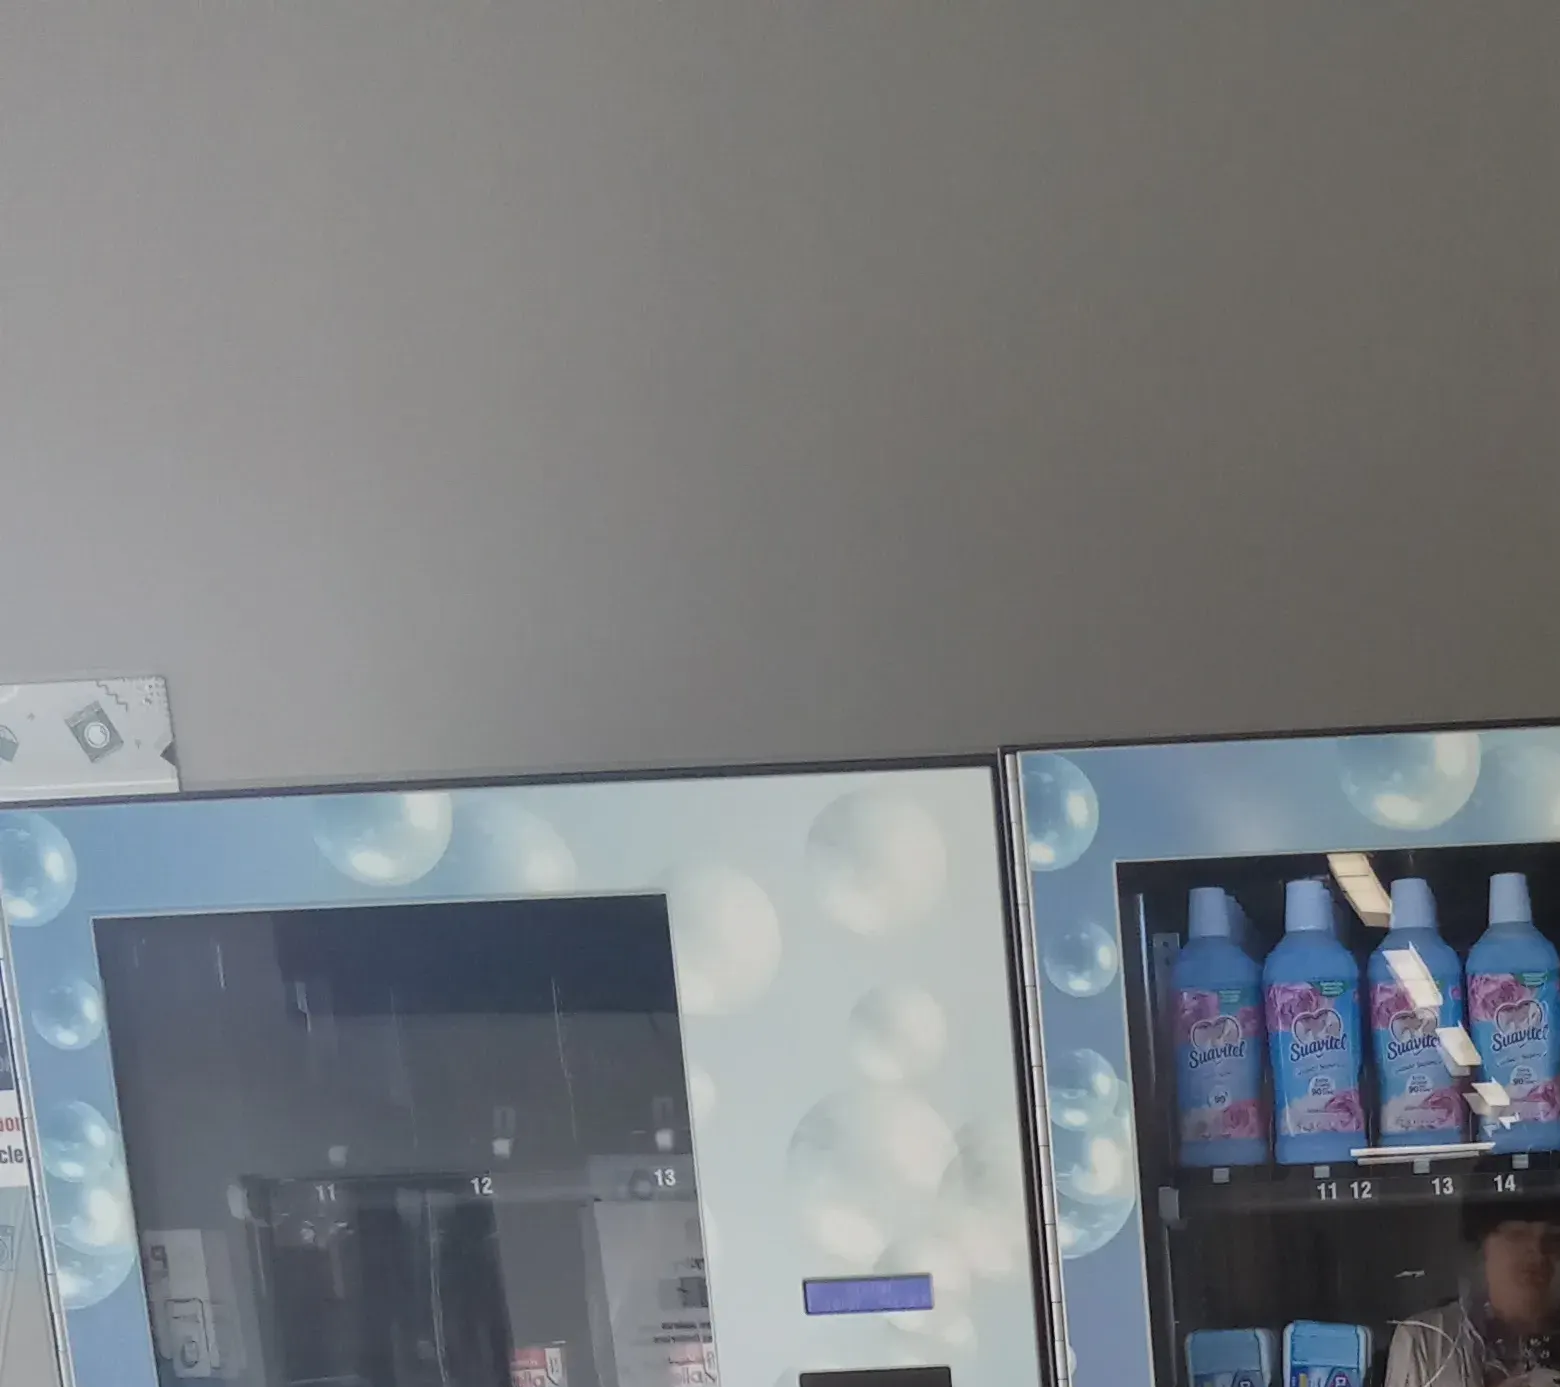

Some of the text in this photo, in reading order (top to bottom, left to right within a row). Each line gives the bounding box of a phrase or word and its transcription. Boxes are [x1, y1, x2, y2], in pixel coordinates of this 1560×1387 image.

[1188, 1040, 1247, 1070] Suavitel
[1290, 1033, 1348, 1063] Suavitel
[1388, 1033, 1441, 1061] Suavite
[471, 1177, 494, 1196] 12
[653, 1168, 677, 1187] 13
[1317, 1182, 1338, 1200] 11
[1350, 1181, 1373, 1199] 12
[1431, 1177, 1454, 1195] 13
[1493, 1174, 1517, 1192] 14
[315, 1185, 337, 1204] 11
